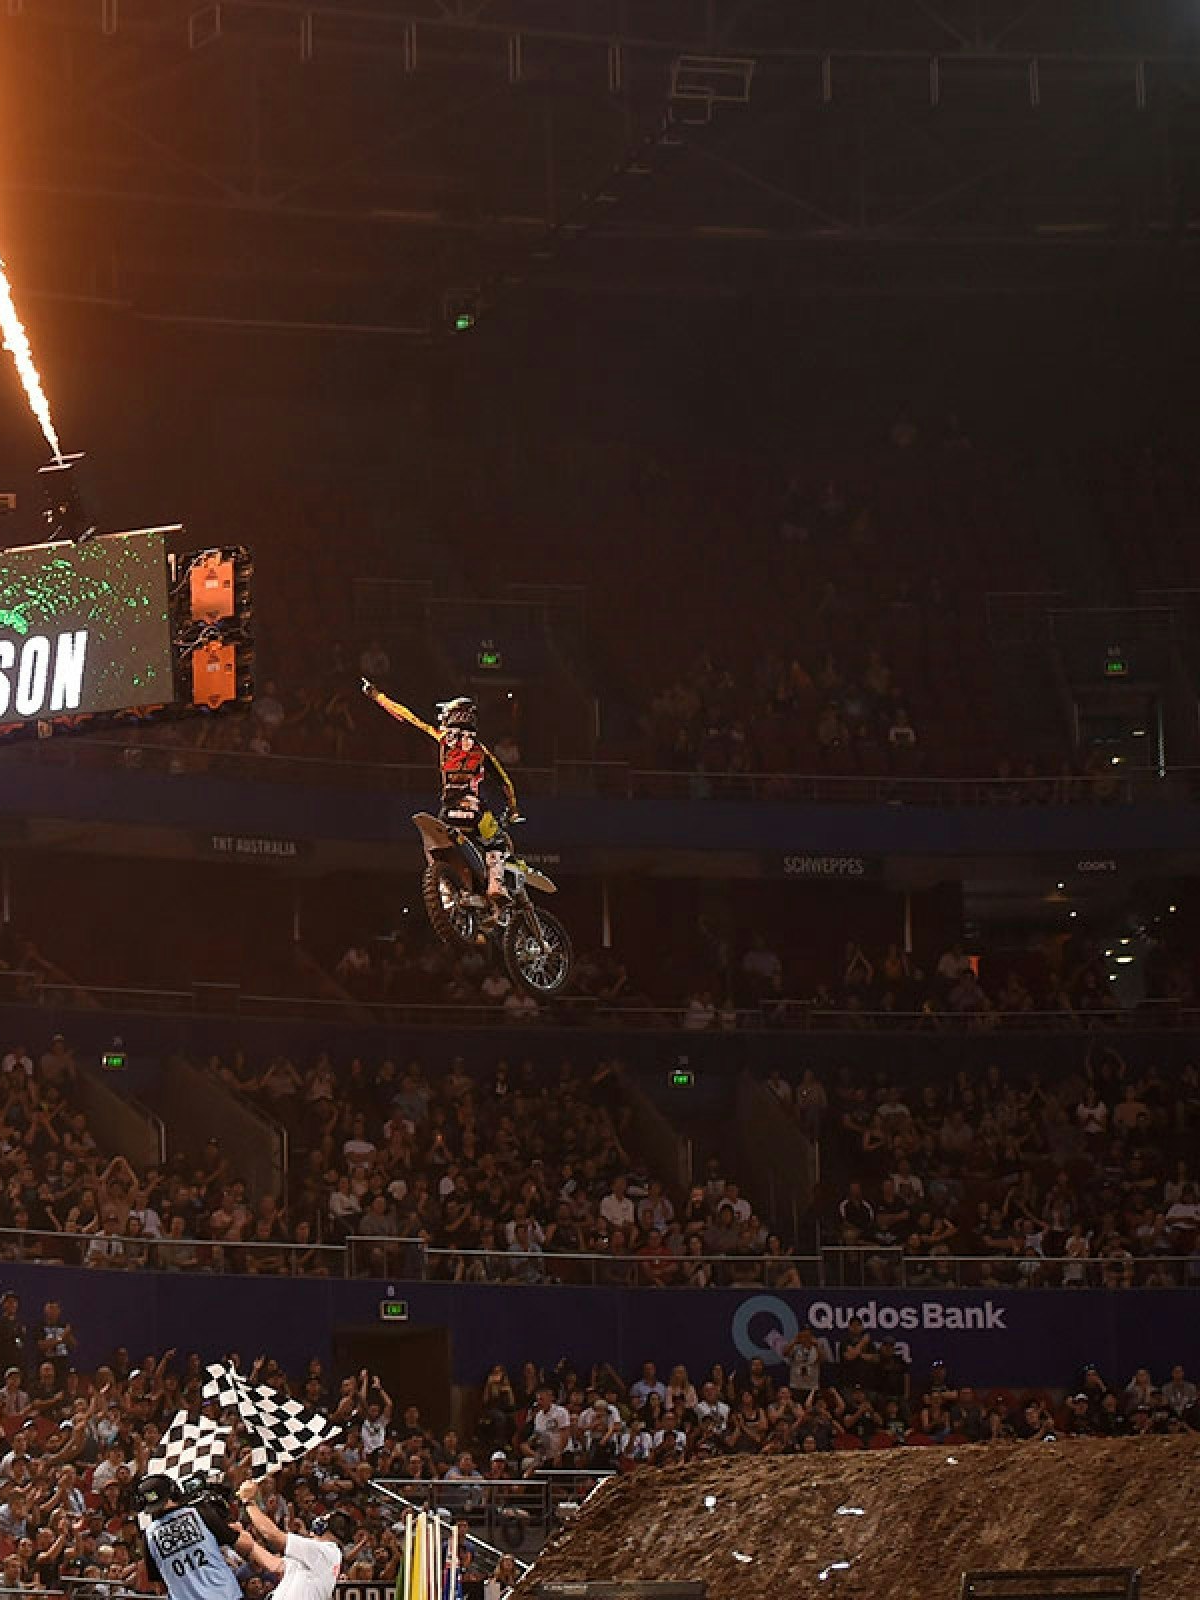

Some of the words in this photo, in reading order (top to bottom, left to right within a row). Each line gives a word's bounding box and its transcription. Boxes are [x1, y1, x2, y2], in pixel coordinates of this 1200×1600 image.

[784, 855, 864, 875] SCHWEPPES
[806, 1300, 920, 1330] Qudos
[922, 1300, 1008, 1330] Bank
[172, 1548, 209, 1576] 012
